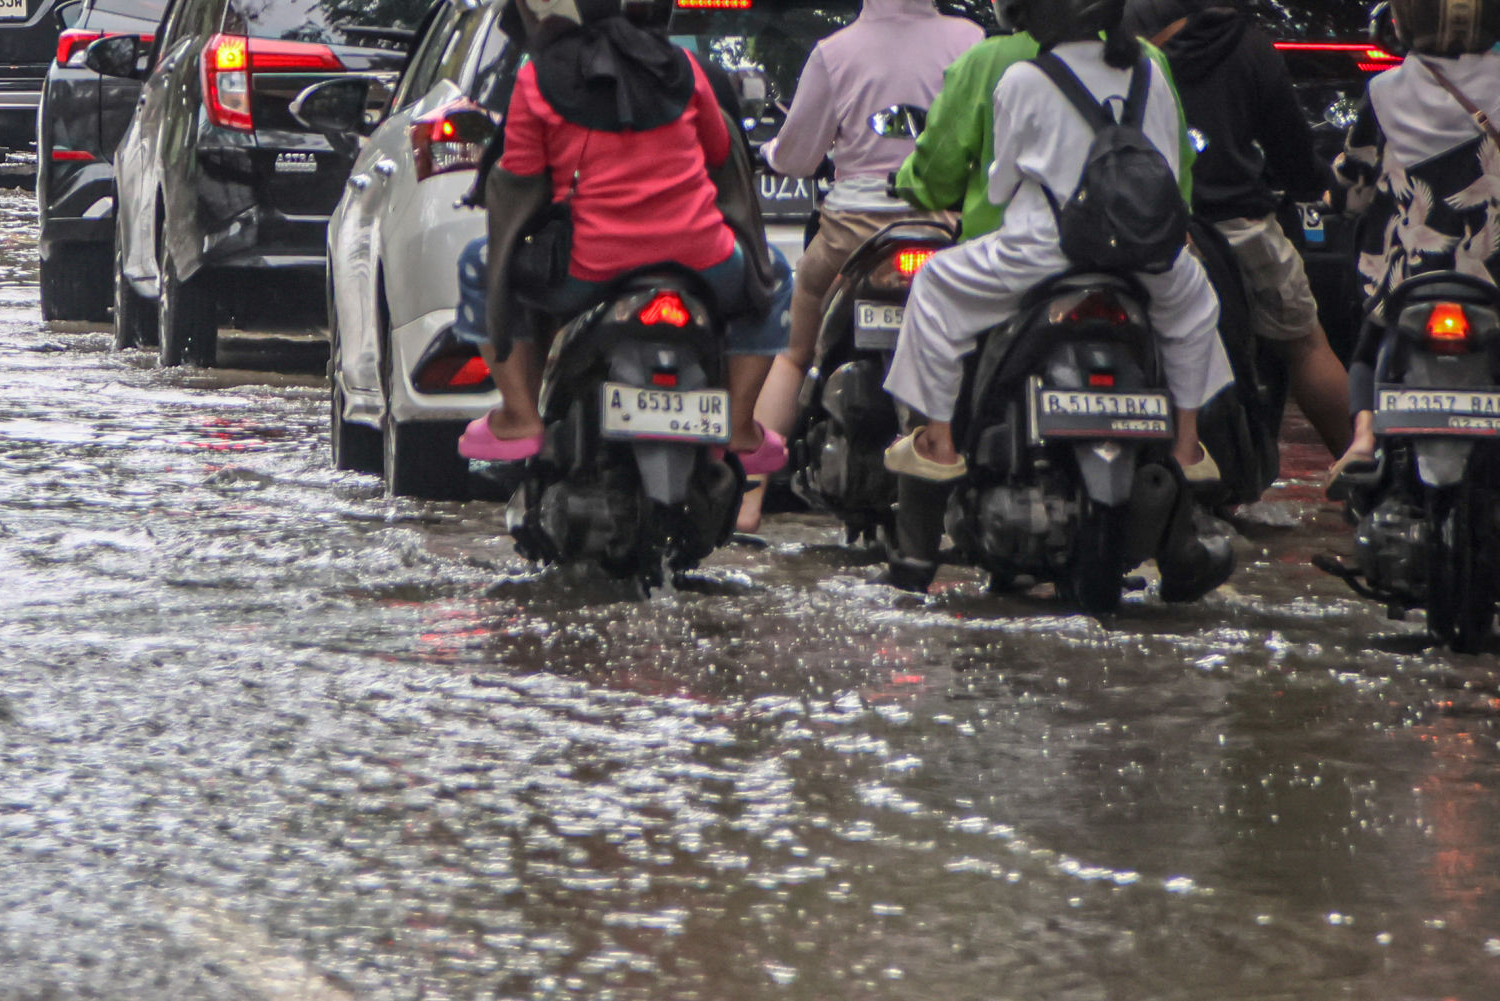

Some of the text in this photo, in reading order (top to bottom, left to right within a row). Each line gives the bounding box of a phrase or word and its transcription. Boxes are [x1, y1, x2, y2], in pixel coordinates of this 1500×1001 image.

[276, 153, 315, 162] ASTRA
[864, 308, 873, 324] B
[610, 389, 721, 414] A 6533 UR
[1049, 395, 1059, 412] B
[1126, 397, 1162, 416] BKJ
[1386, 395, 1397, 411] B
[1407, 395, 1456, 411] 3357
